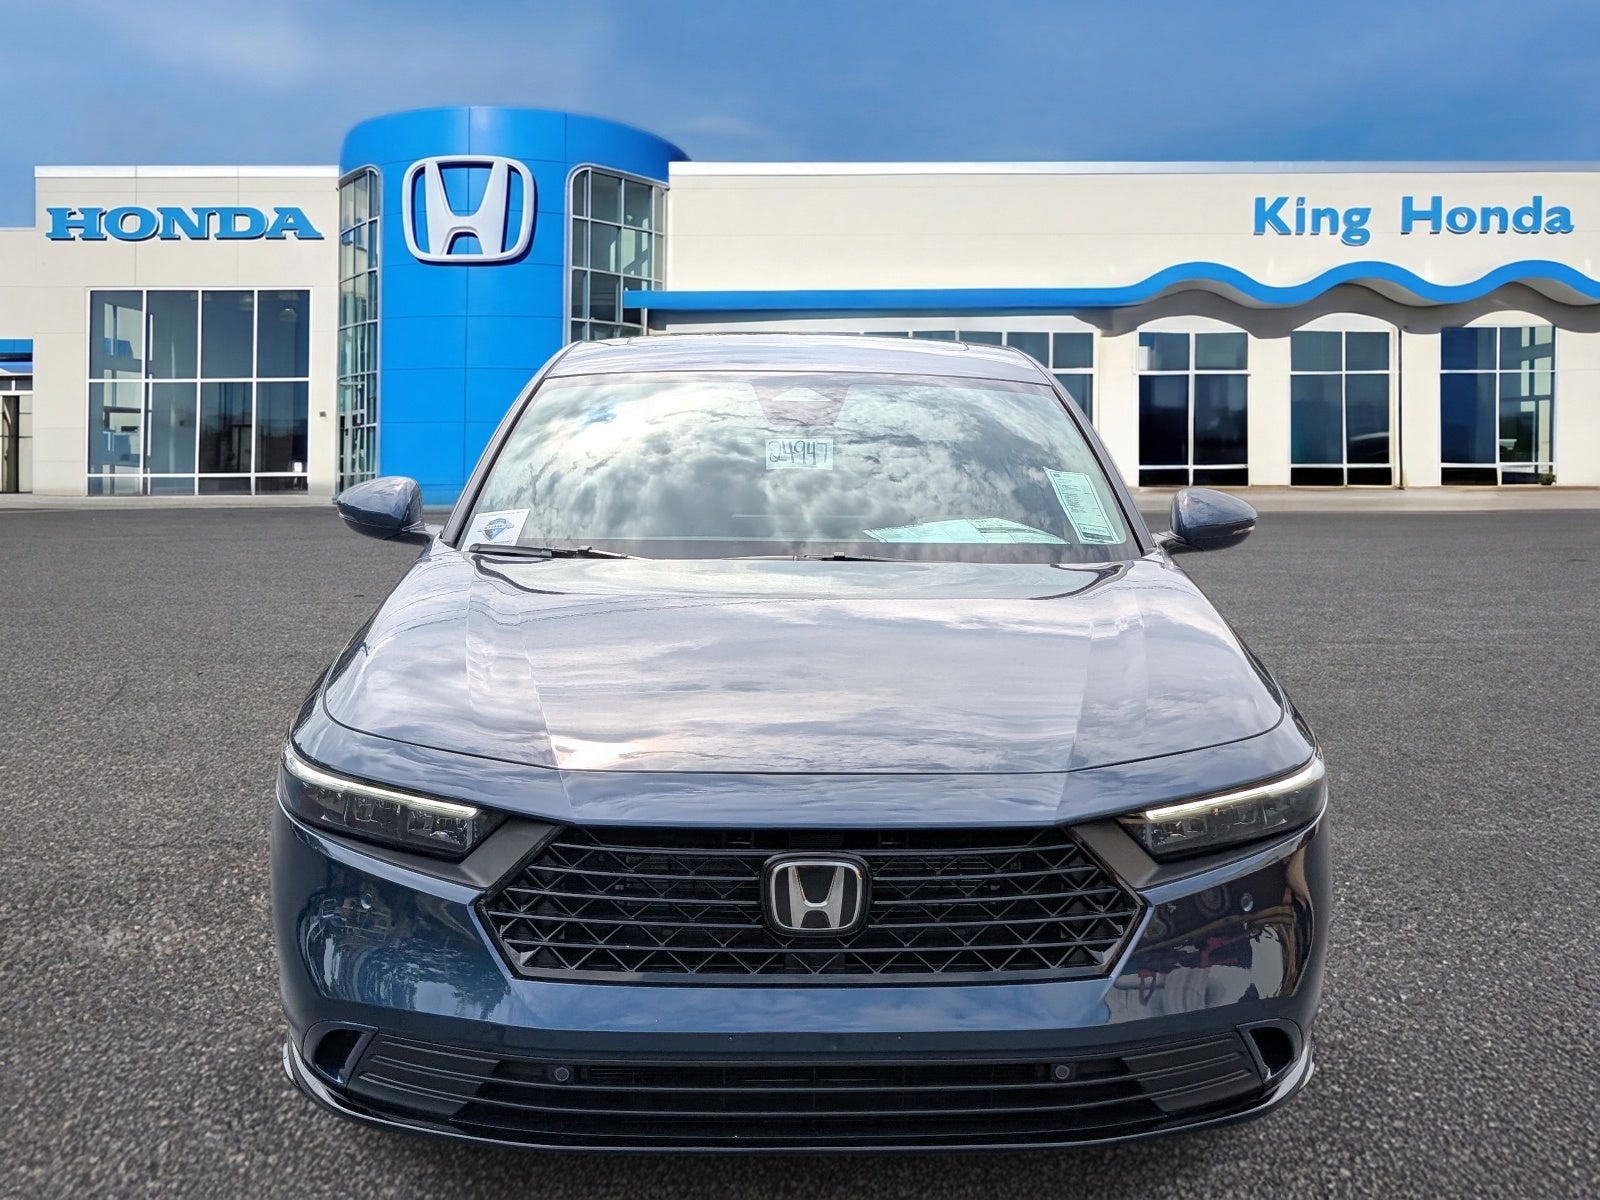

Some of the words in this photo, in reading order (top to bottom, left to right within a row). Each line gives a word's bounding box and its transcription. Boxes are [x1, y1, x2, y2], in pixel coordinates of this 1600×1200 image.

[45, 206, 325, 241] HONDA
[1253, 196, 1372, 247] King
[1401, 195, 1575, 235] Honda
[768, 440, 828, 466] 24947
